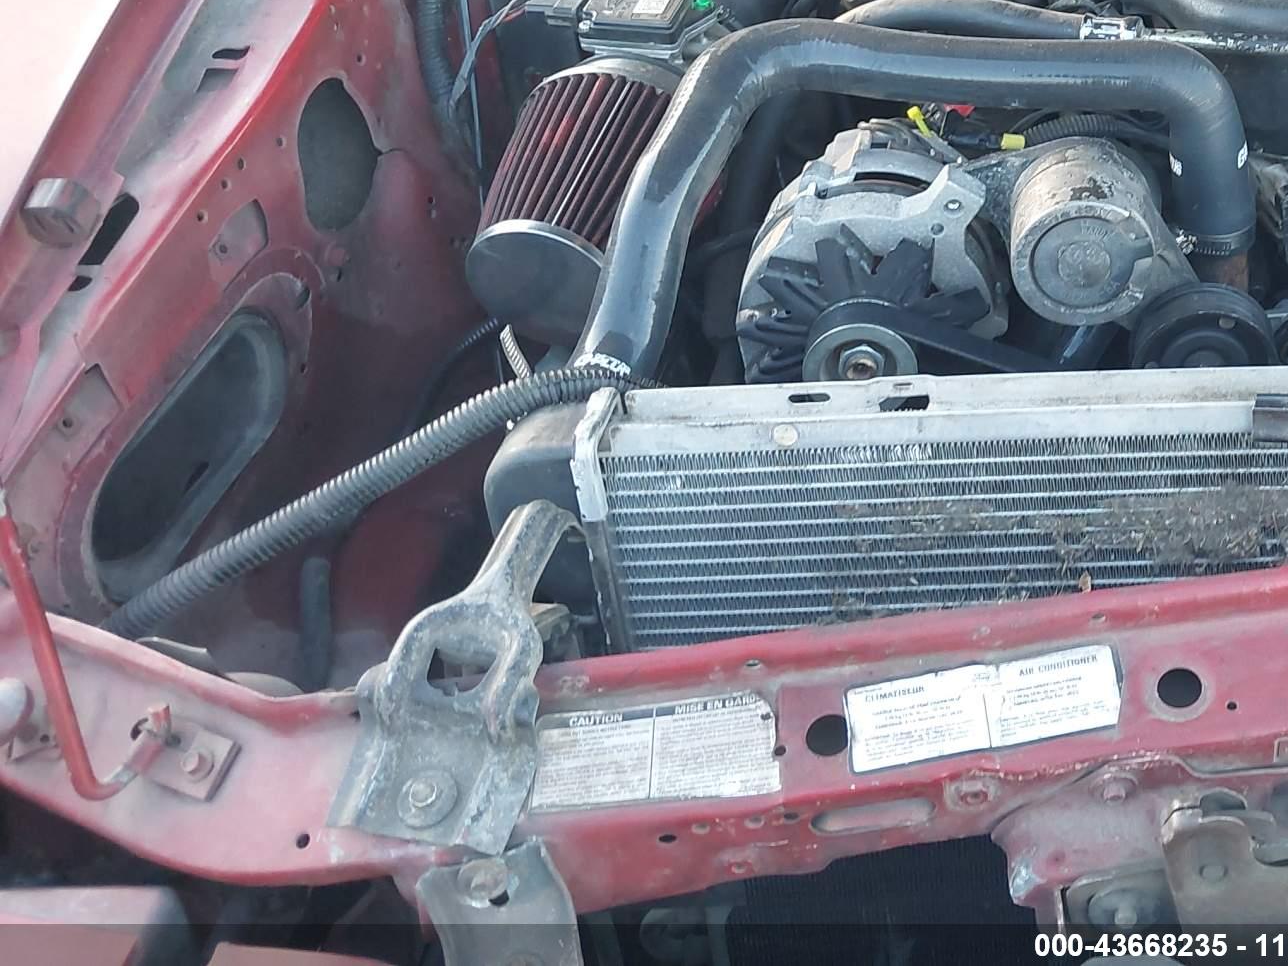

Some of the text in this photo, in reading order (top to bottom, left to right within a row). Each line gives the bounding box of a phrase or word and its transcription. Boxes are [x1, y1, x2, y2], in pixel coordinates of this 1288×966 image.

[1019, 653, 1098, 677] AIR CONDITIONER
[674, 702, 705, 716] MISE
[707, 698, 724, 710] EN
[568, 712, 624, 728] CAUTION
